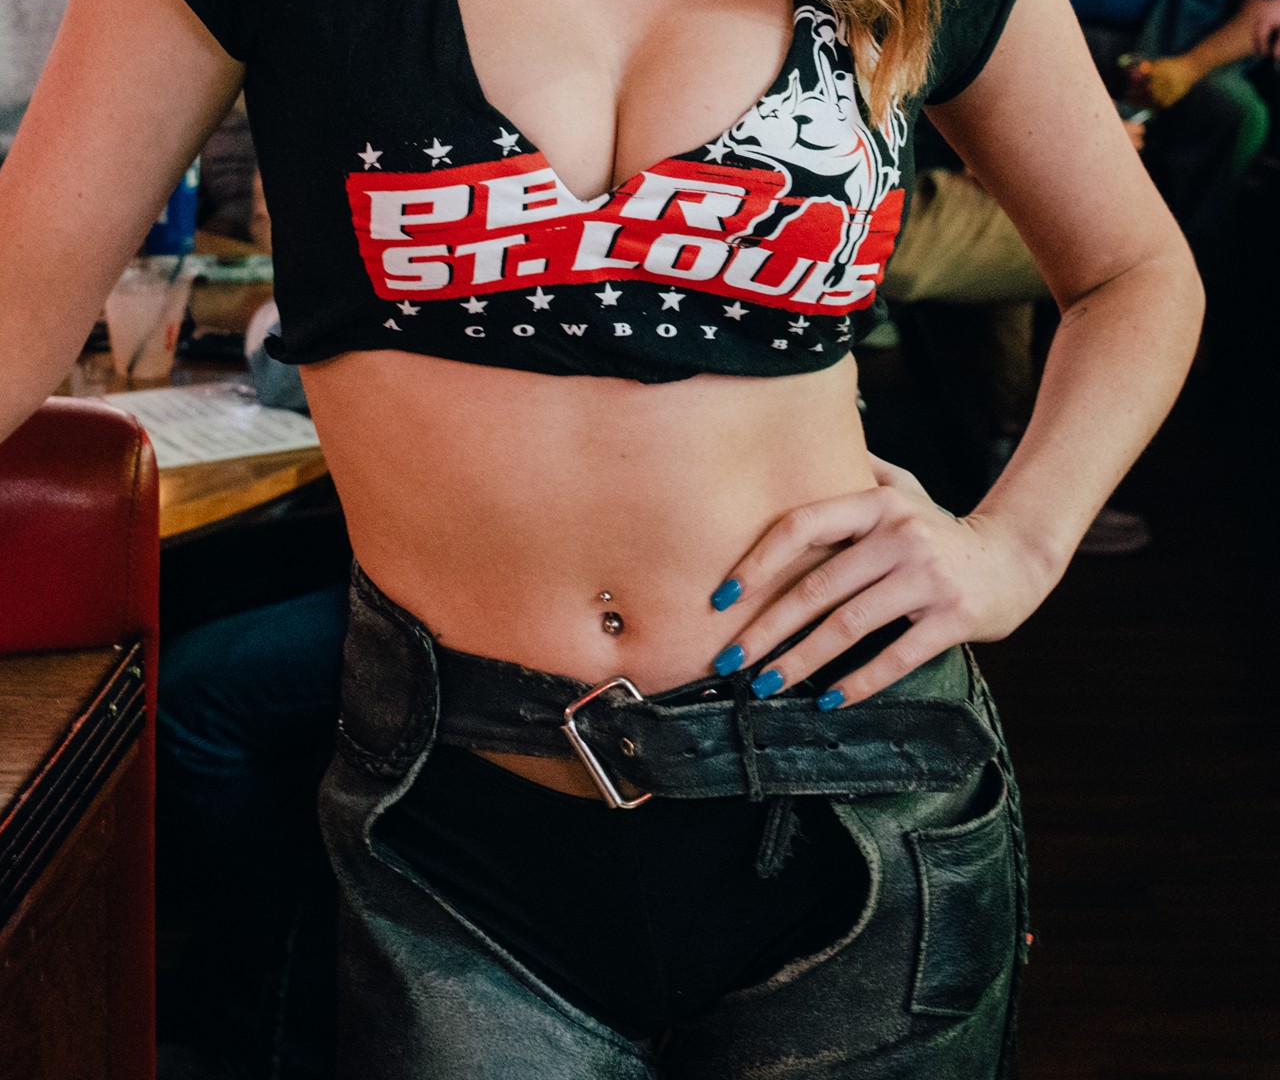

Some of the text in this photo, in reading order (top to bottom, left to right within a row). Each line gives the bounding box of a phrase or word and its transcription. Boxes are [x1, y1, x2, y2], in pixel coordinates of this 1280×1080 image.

[363, 167, 749, 240] PBR
[381, 220, 880, 307] ST. LOUIS
[383, 317, 402, 332] A
[465, 321, 718, 340] COWBOY
